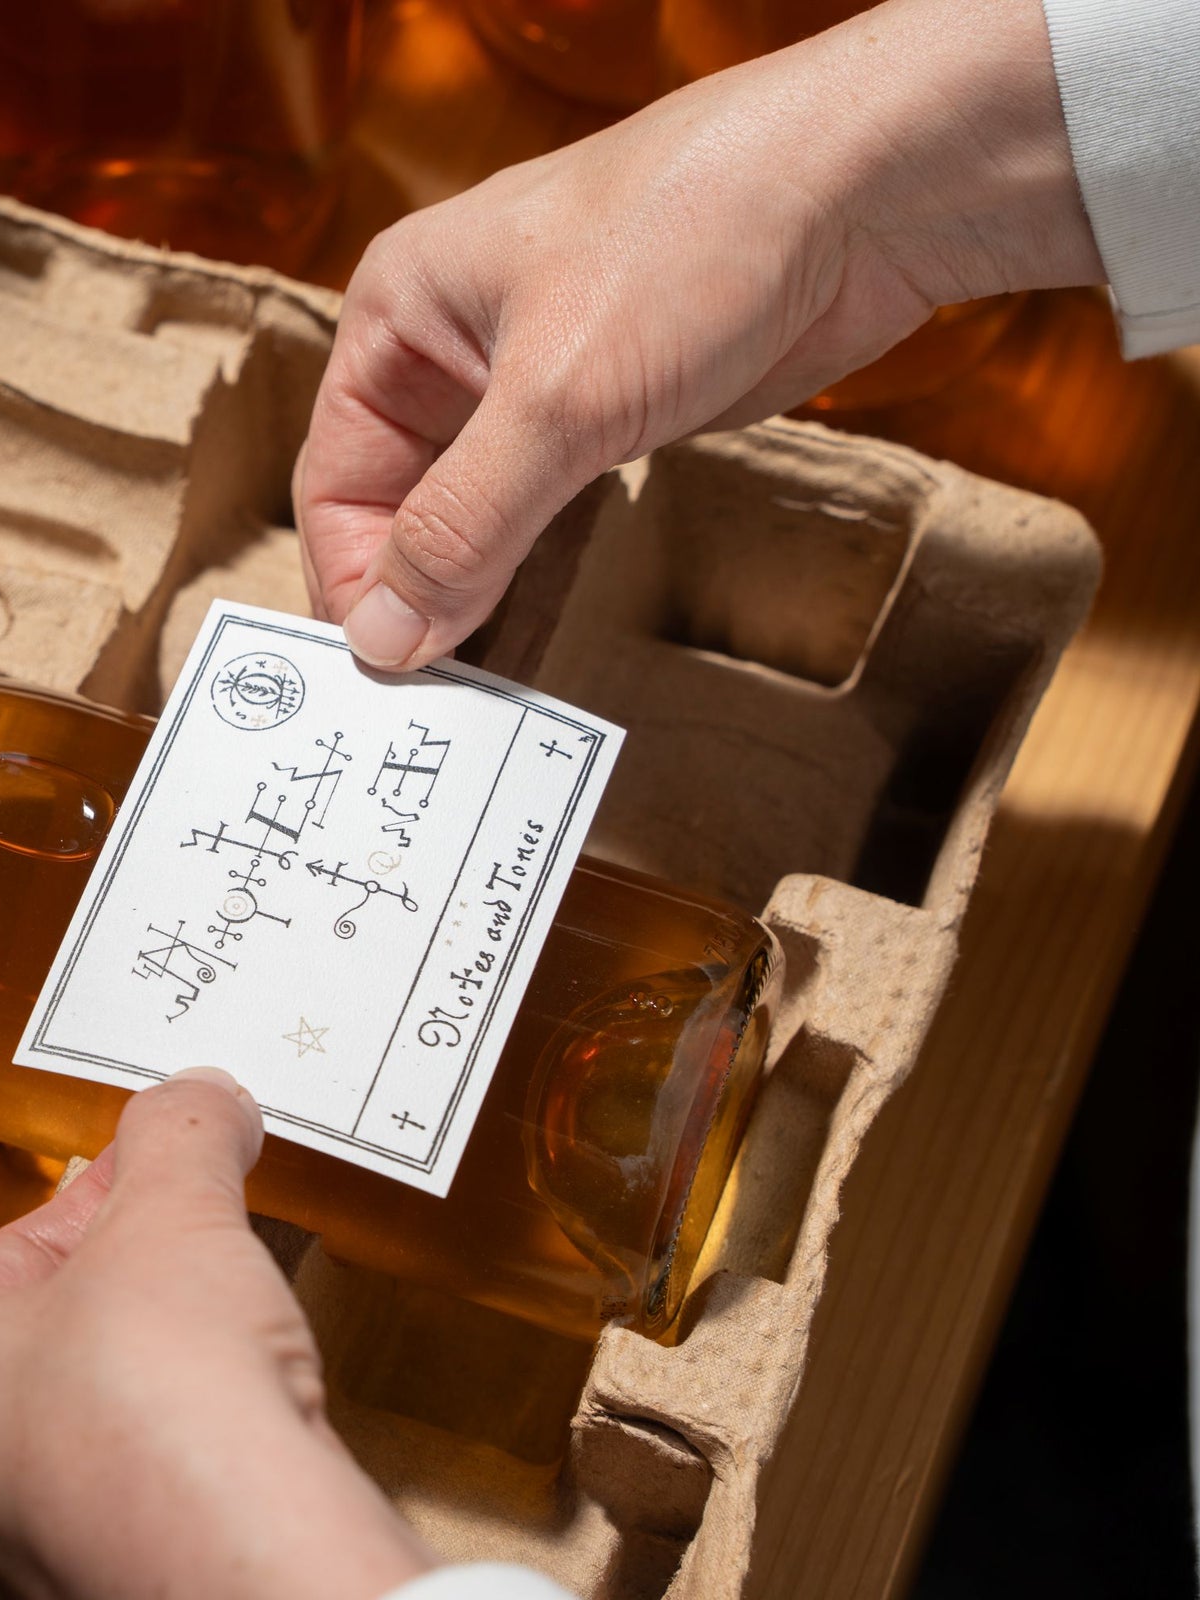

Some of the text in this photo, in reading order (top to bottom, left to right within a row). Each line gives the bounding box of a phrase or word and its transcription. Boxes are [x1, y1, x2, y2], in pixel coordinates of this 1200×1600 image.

[417, 818, 545, 1048] Notes and Tones
